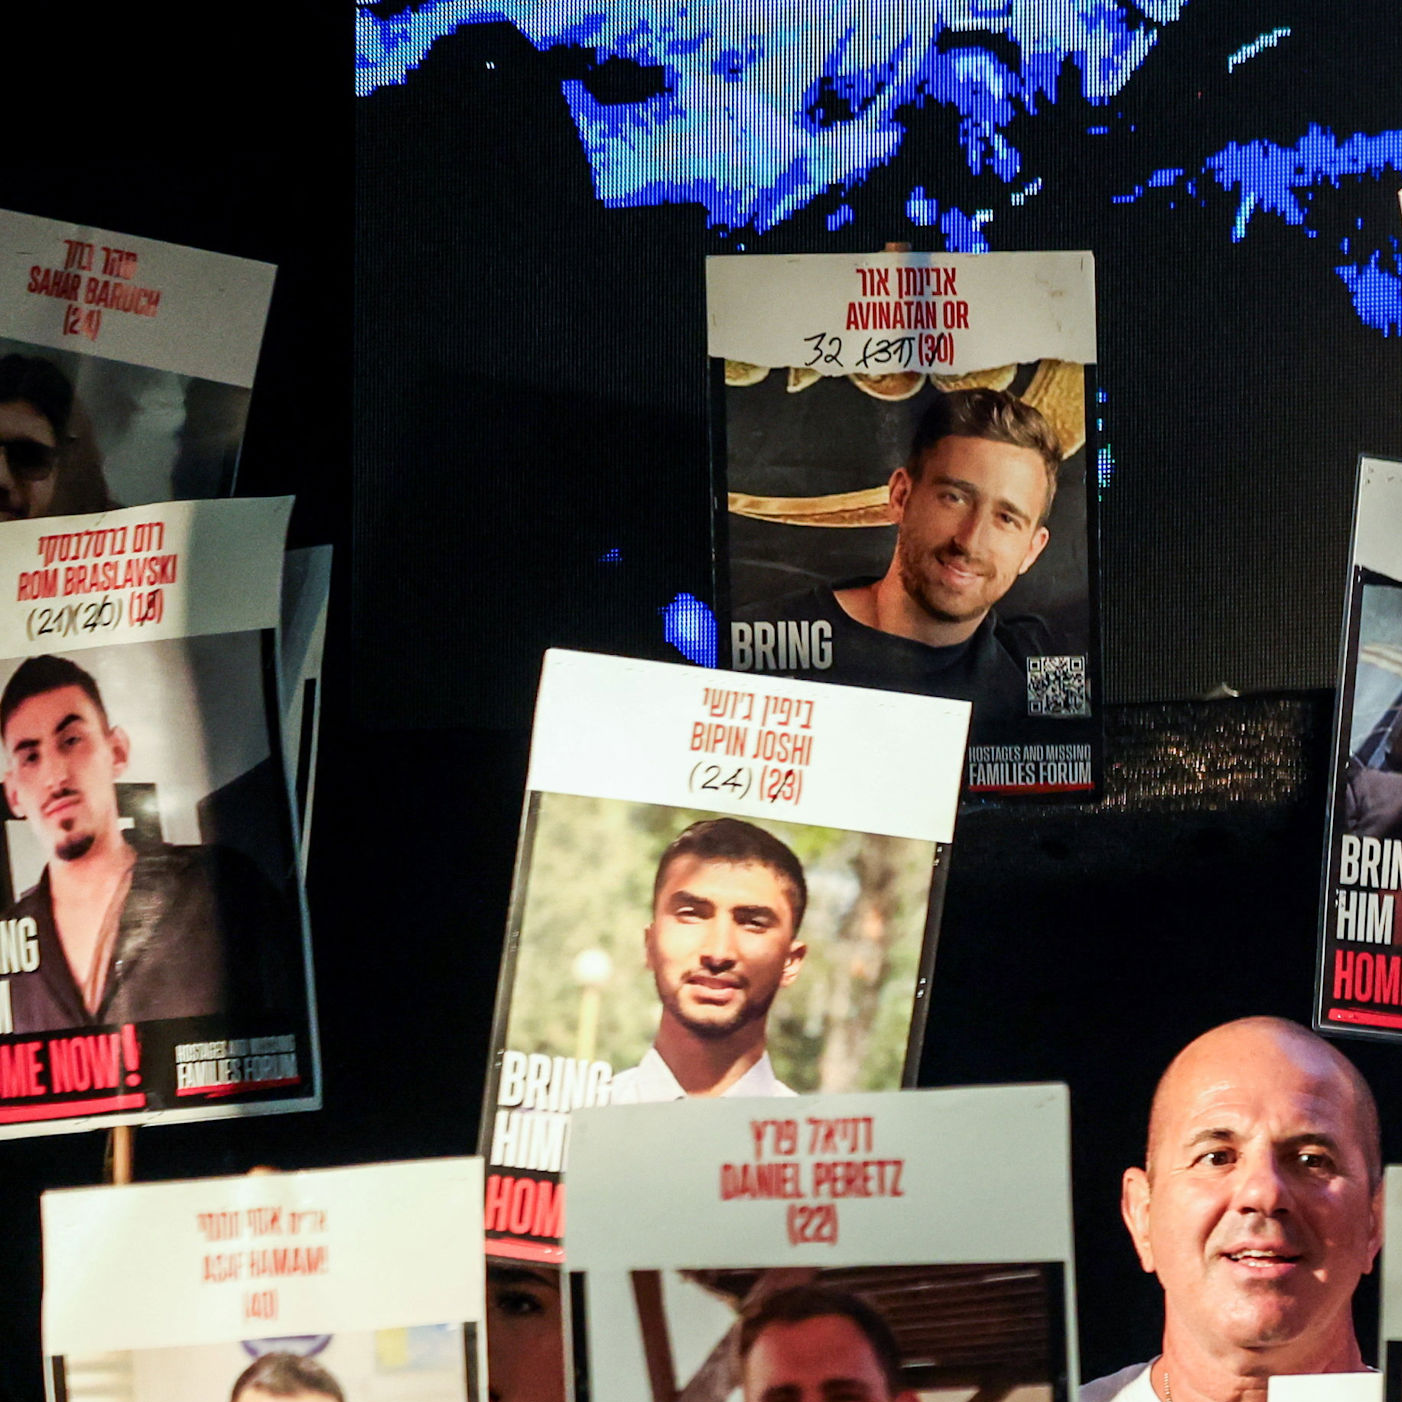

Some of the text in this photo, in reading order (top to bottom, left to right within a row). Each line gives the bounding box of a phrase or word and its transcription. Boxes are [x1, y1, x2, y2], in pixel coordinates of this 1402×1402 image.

[27, 265, 162, 317] SAHAR BARUCH
[856, 267, 958, 299] אבינתן אור
[846, 301, 970, 330] AVINATAN OR
[133, 522, 165, 553] רום
[17, 554, 178, 601] ROM BRASLAVSKI
[731, 620, 834, 671] BRING
[761, 695, 815, 730] ביפין
[690, 721, 813, 766] BIPIN JOSHI
[969, 743, 1091, 761] HOSTAGES MISSING
[969, 761, 1092, 787] FAMILIES FORUM
[1335, 889, 1395, 945] HIM
[719, 1160, 906, 1201] DANIEL PERETZ
[787, 1202, 839, 1246] (22)
